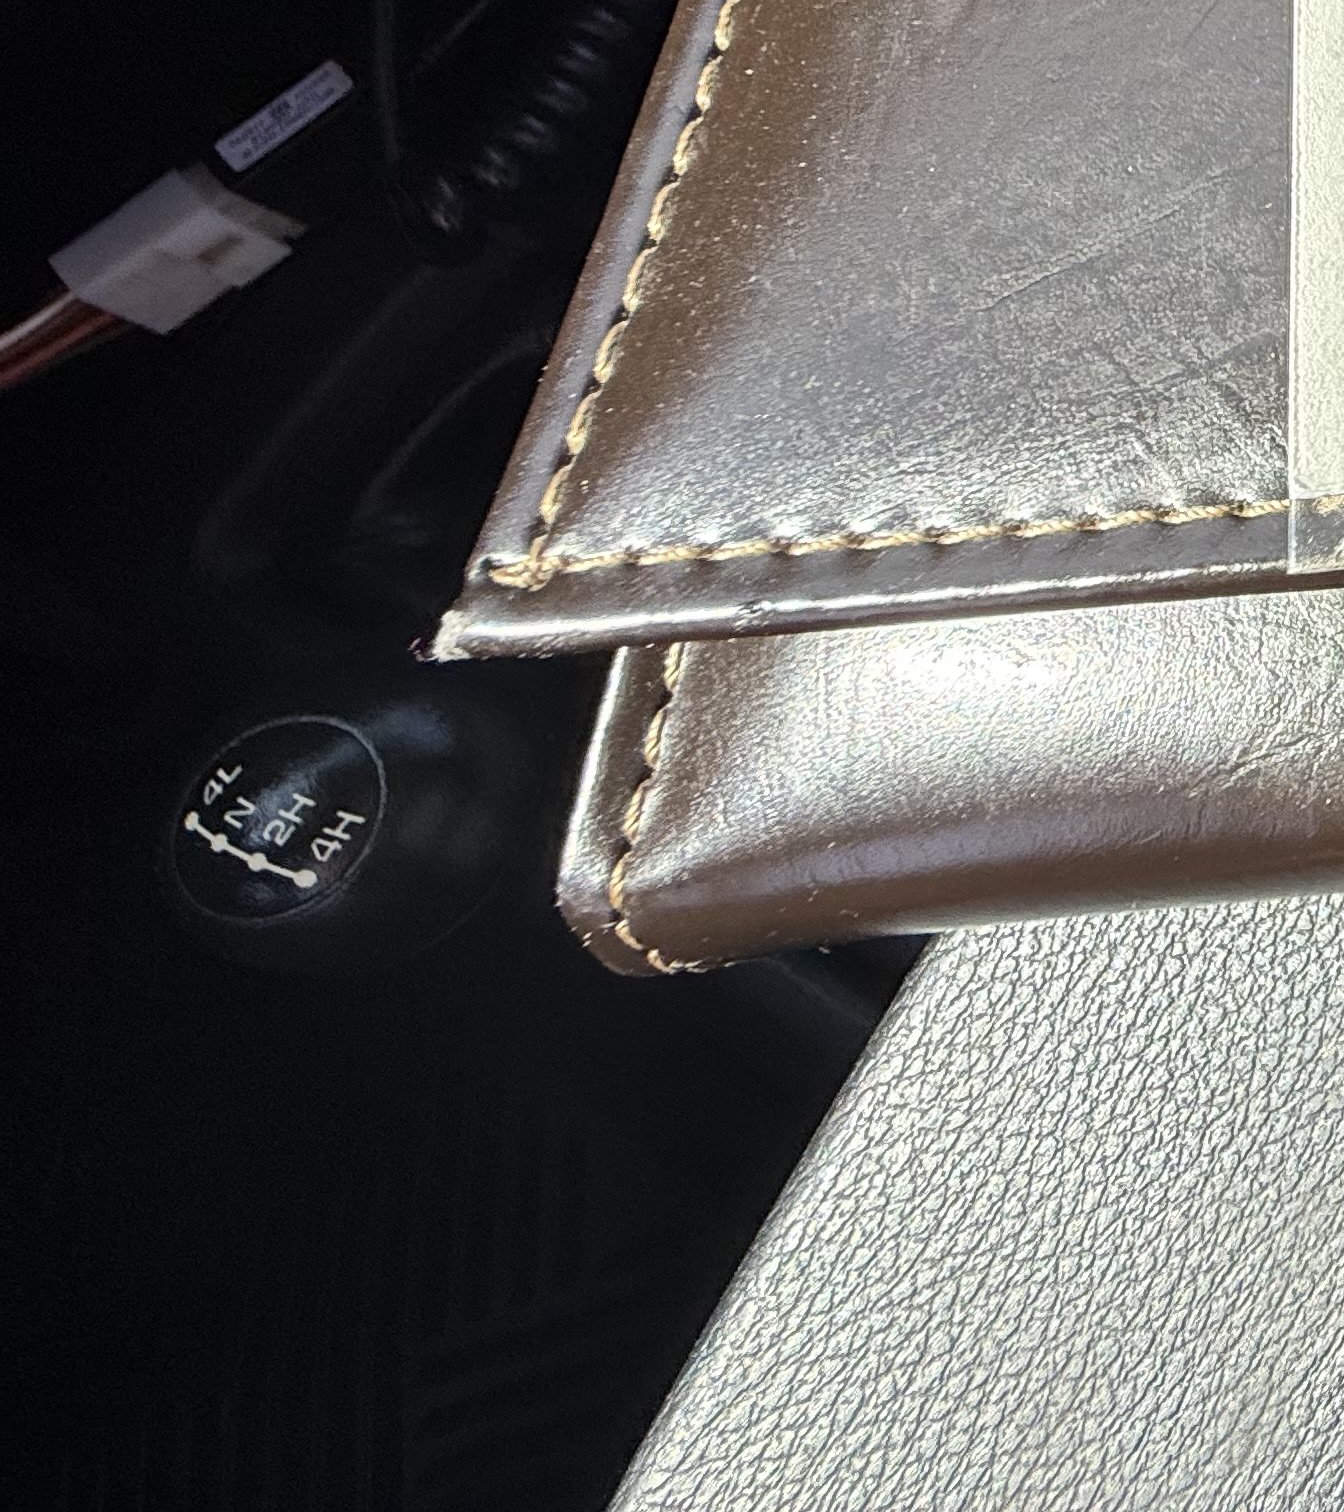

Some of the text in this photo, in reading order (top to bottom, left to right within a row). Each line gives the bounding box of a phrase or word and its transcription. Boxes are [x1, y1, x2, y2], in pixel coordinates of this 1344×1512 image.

[203, 764, 244, 806] 4L
[223, 796, 256, 829] N
[262, 792, 317, 847] 2H
[310, 809, 366, 863] 4H
